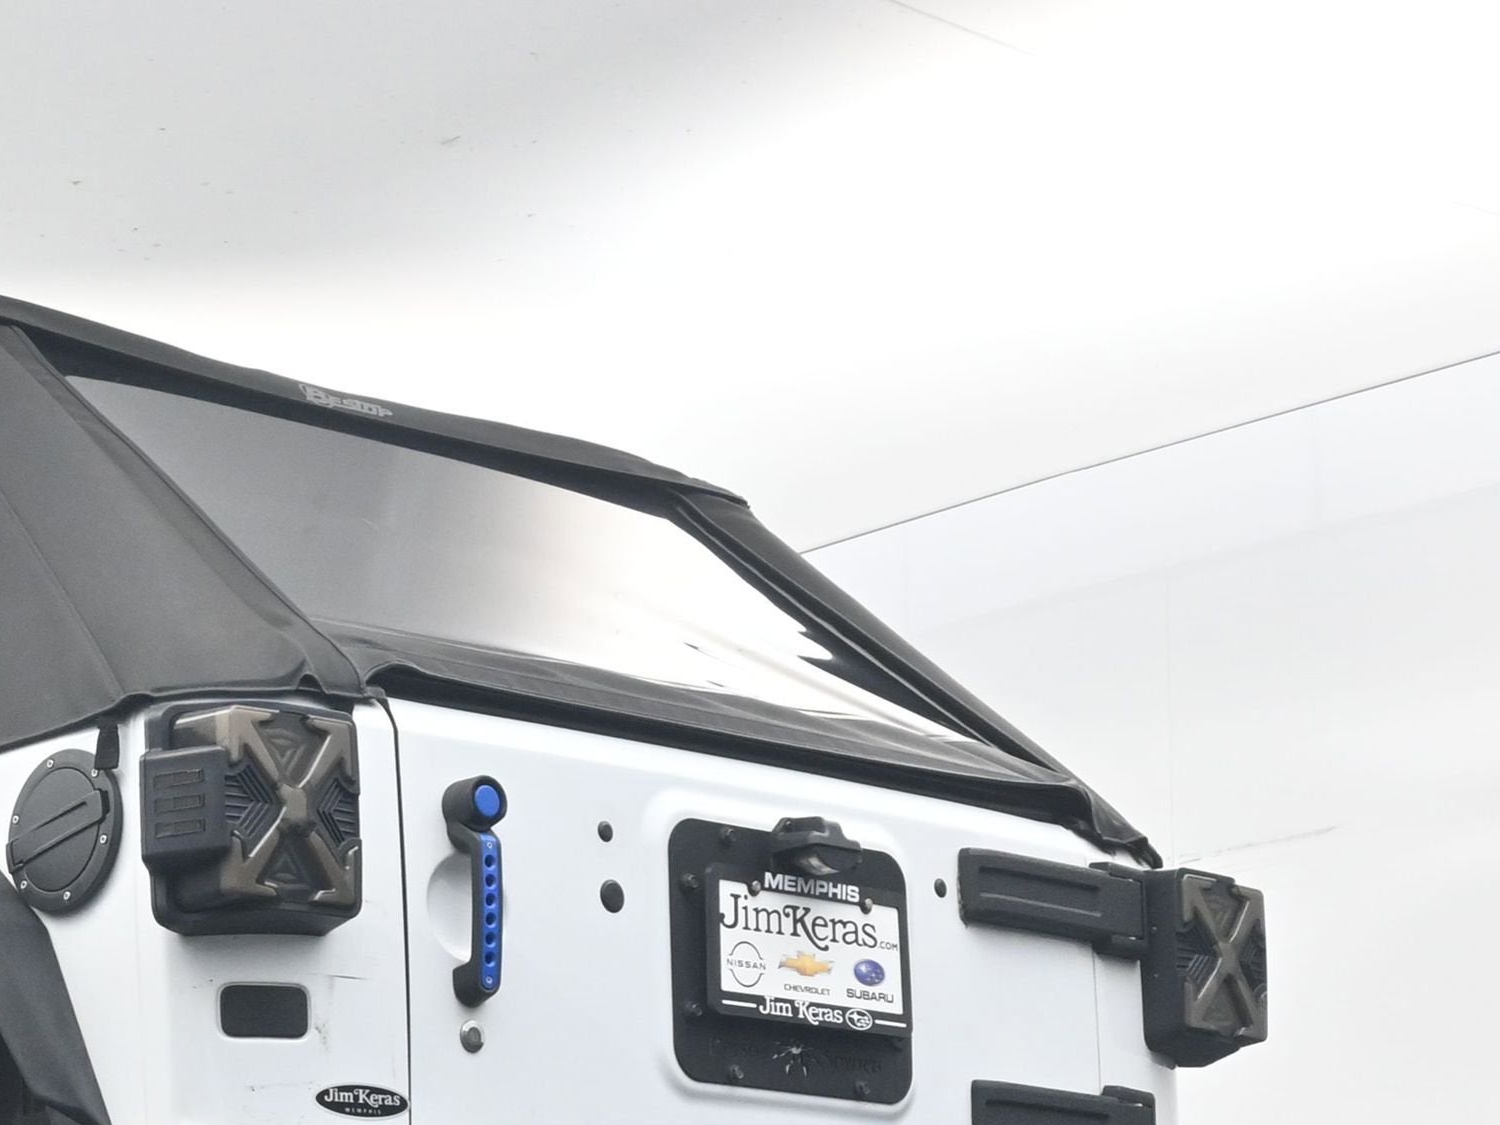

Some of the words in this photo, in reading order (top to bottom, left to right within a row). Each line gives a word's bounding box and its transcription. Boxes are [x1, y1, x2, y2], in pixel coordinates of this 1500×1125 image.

[764, 872, 860, 902] MEMPHIS
[726, 958, 766, 970] NISSAN
[784, 983, 831, 995] CHEVROLET
[846, 988, 894, 1003] SUBARU
[759, 996, 792, 1016] Jim
[795, 1001, 844, 1025] Keras
